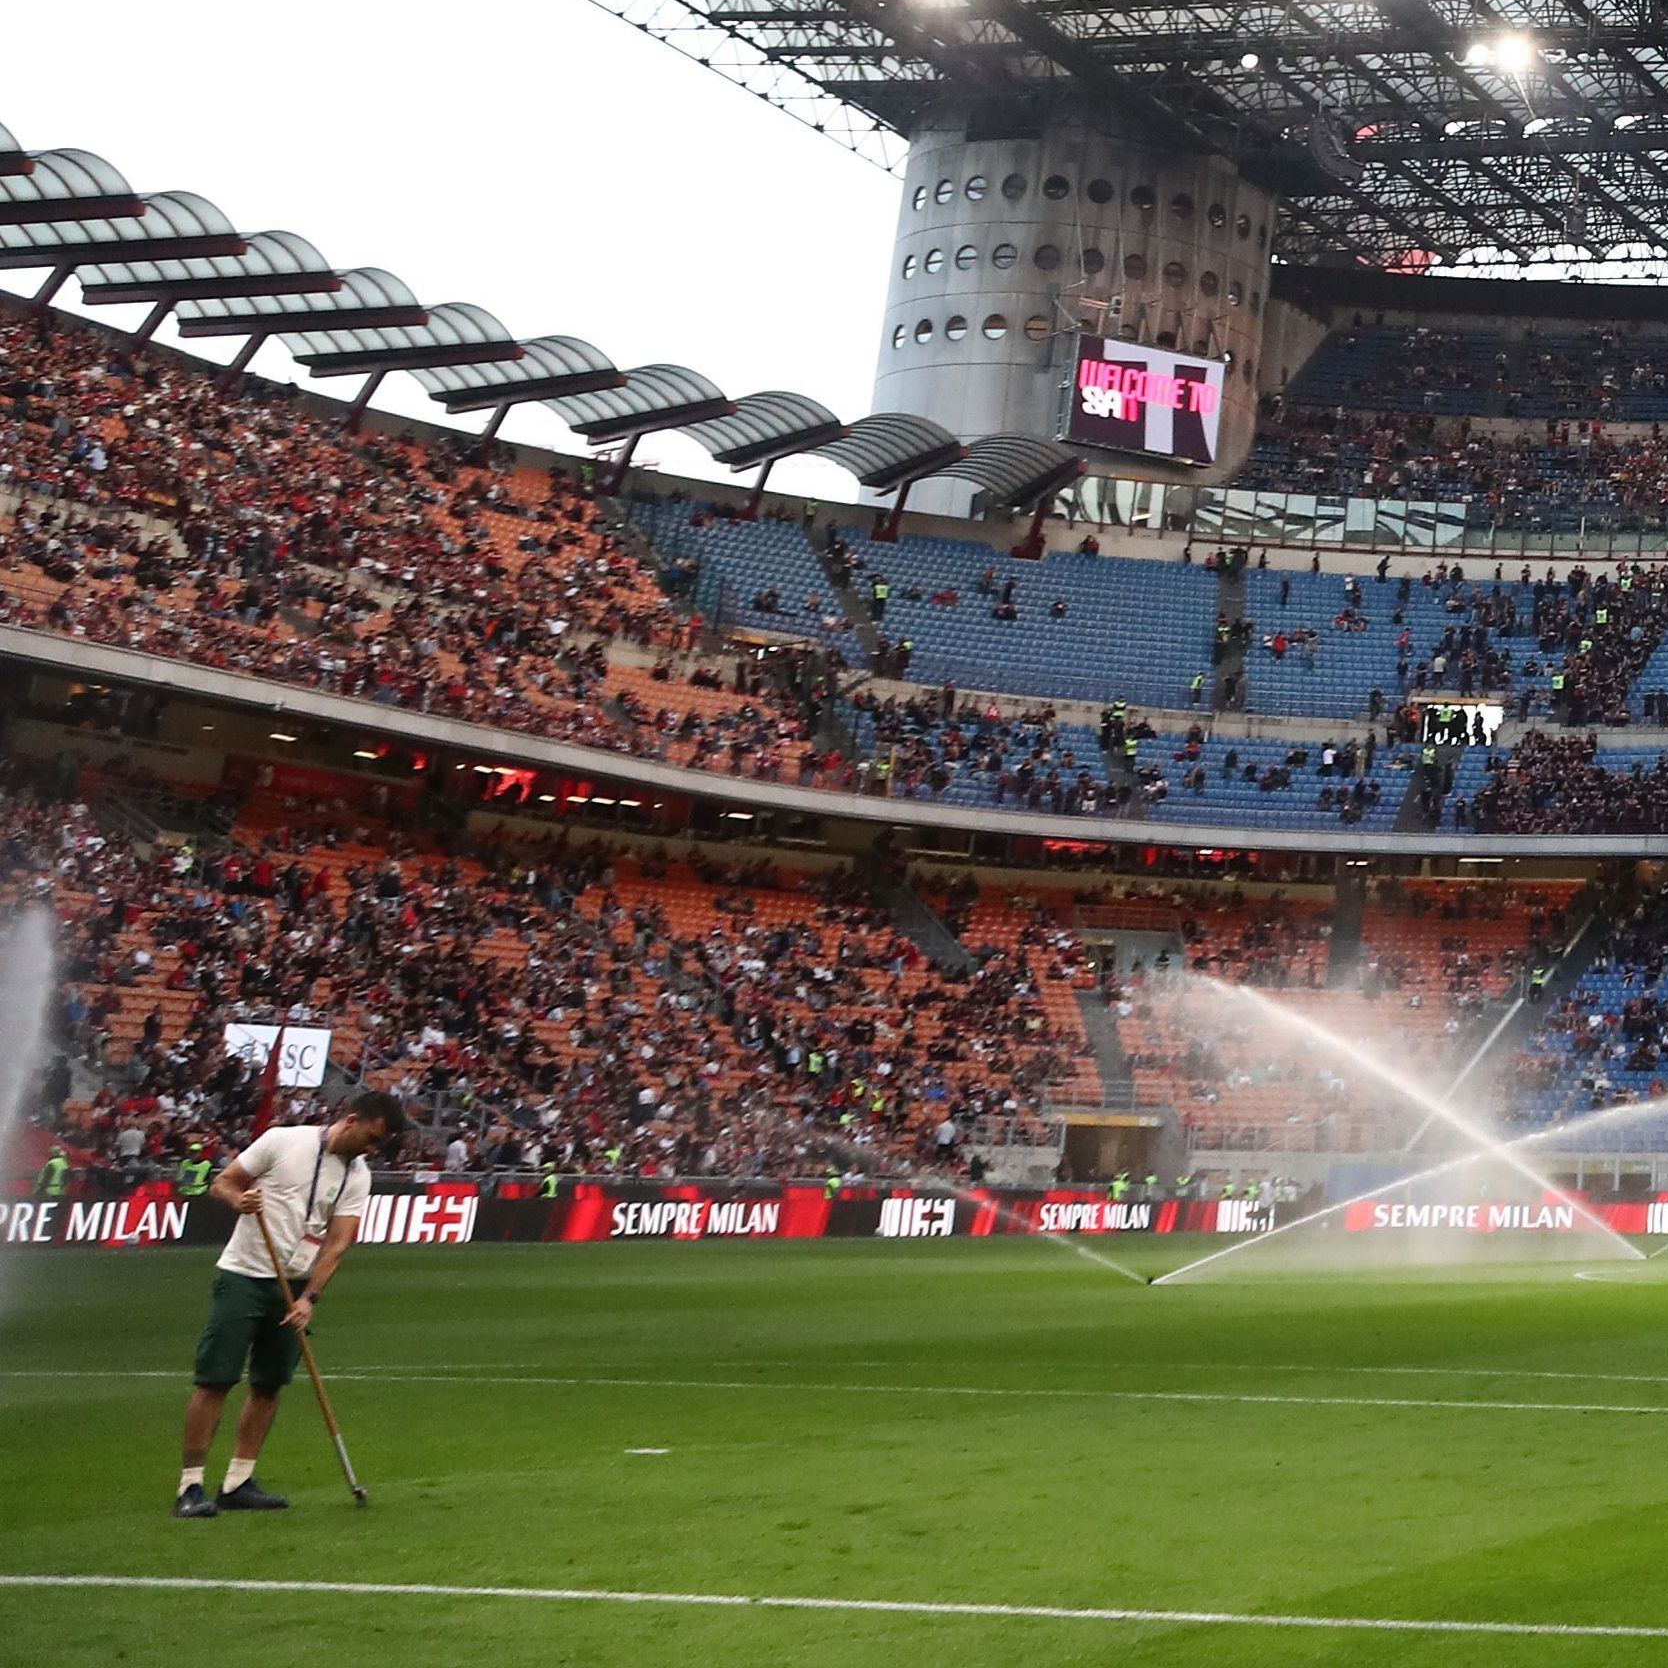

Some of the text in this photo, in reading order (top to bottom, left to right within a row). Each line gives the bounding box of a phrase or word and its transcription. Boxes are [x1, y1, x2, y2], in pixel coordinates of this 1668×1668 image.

[1079, 359, 1217, 417] WELCOME TO
[65, 1201, 190, 1242] MILAN
[611, 1202, 780, 1236] SEMPRE MILAN
[1039, 1204, 1150, 1231] SEMPRE MILAN
[1373, 1204, 1574, 1229] SEMPRE MILAN
